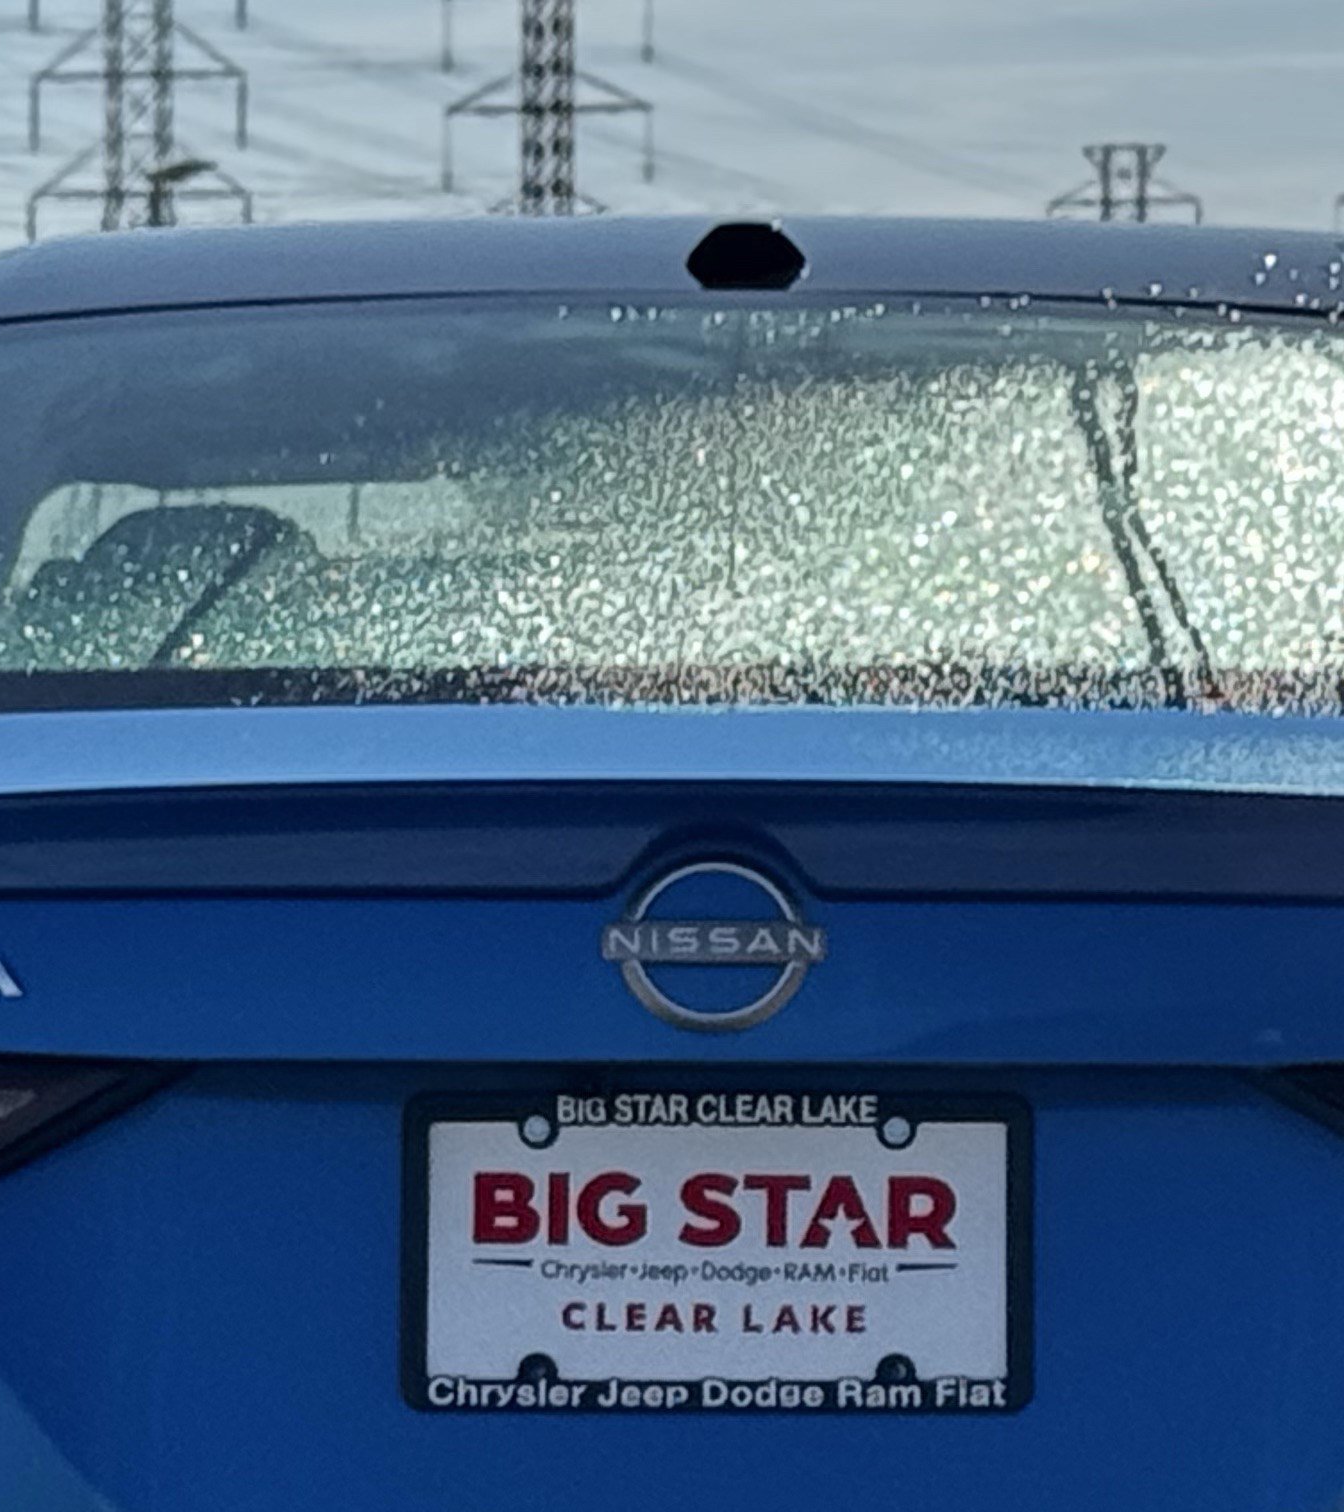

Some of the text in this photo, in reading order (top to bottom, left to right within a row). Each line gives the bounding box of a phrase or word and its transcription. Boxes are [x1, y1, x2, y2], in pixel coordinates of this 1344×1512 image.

[607, 926, 822, 956] NISSAN
[556, 1094, 878, 1123] BIG STAR CLEAR LAKE
[472, 1171, 958, 1249] BIG STAR
[540, 1258, 890, 1287] Chrysler Jeep Dodge RAM Fiat
[561, 1302, 869, 1334] CLEAR LAKE
[427, 1377, 1007, 1410] Chrysler Jeep Dodge Ram Fiat
